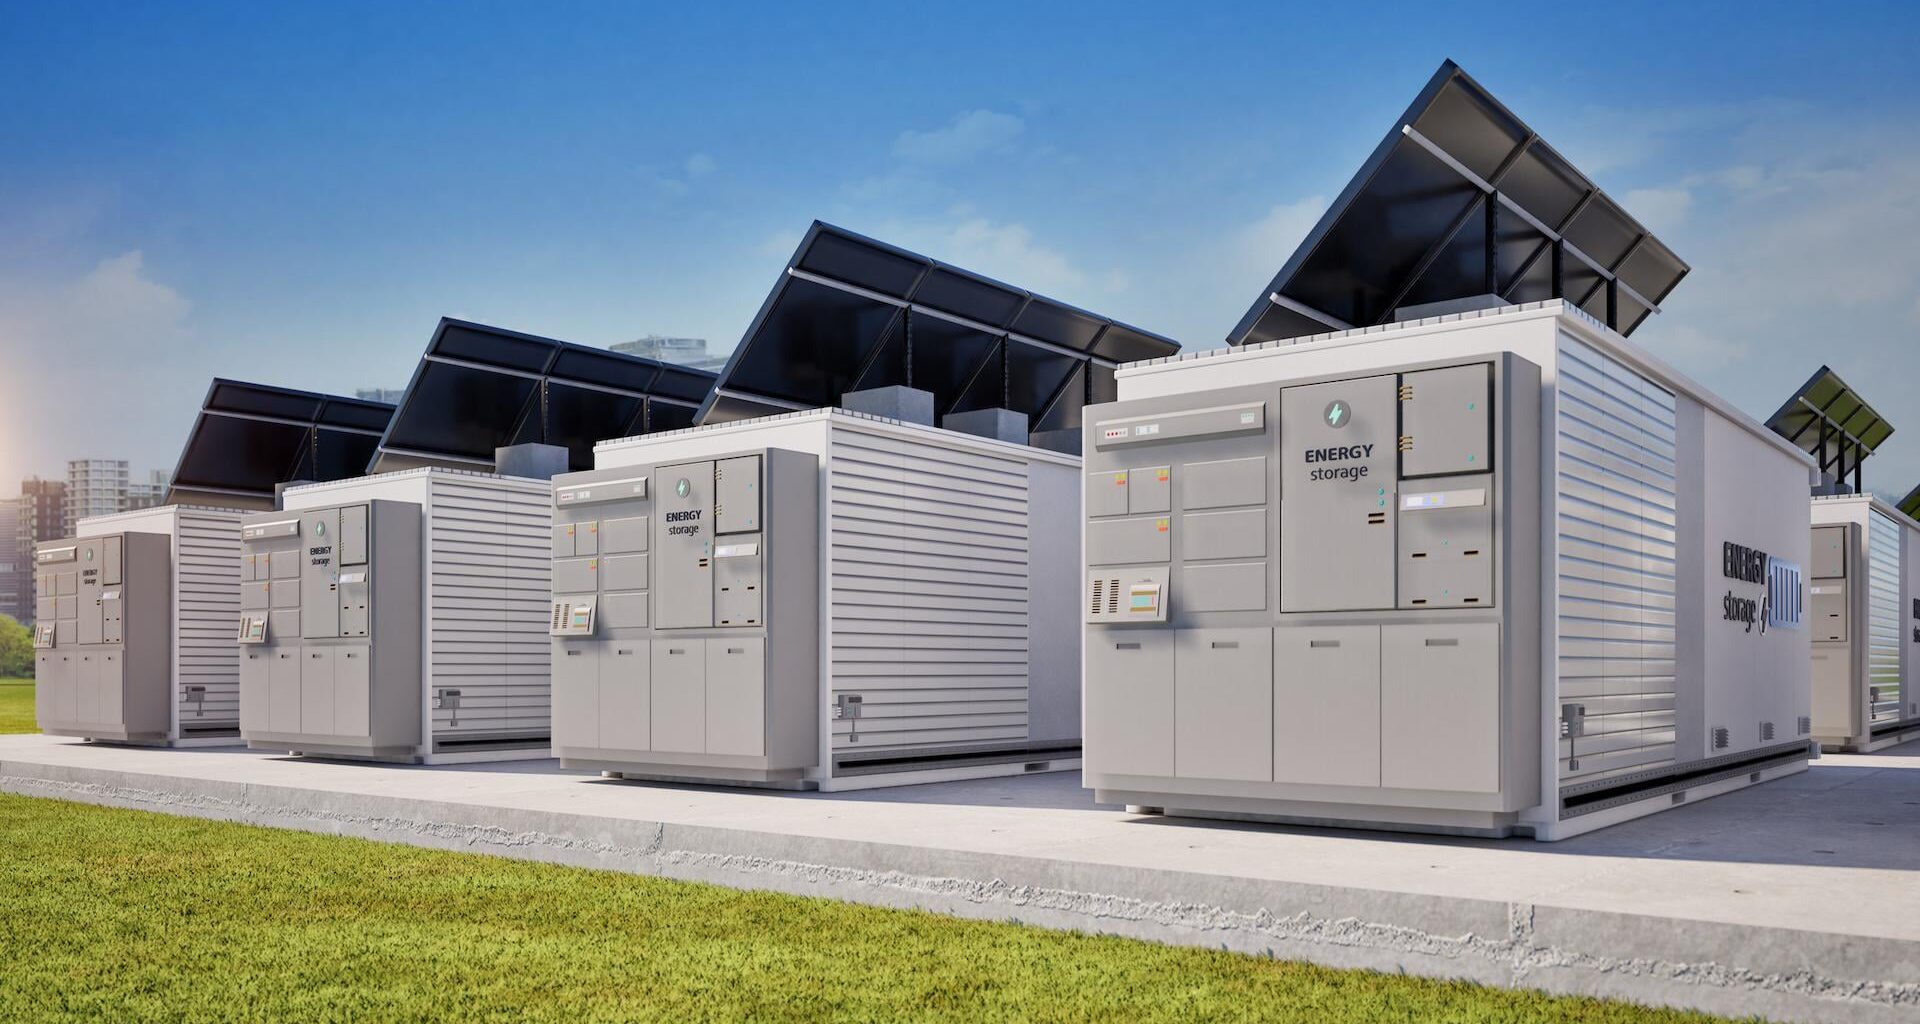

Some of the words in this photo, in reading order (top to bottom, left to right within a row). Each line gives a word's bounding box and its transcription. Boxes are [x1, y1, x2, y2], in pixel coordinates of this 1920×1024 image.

[1305, 444, 1374, 463] ENERGY
[1310, 464, 1368, 482] storage
[666, 510, 702, 522] ENERGY
[668, 524, 699, 537] storage
[1723, 541, 1768, 585] ENERGY
[1723, 590, 1756, 633] storage
